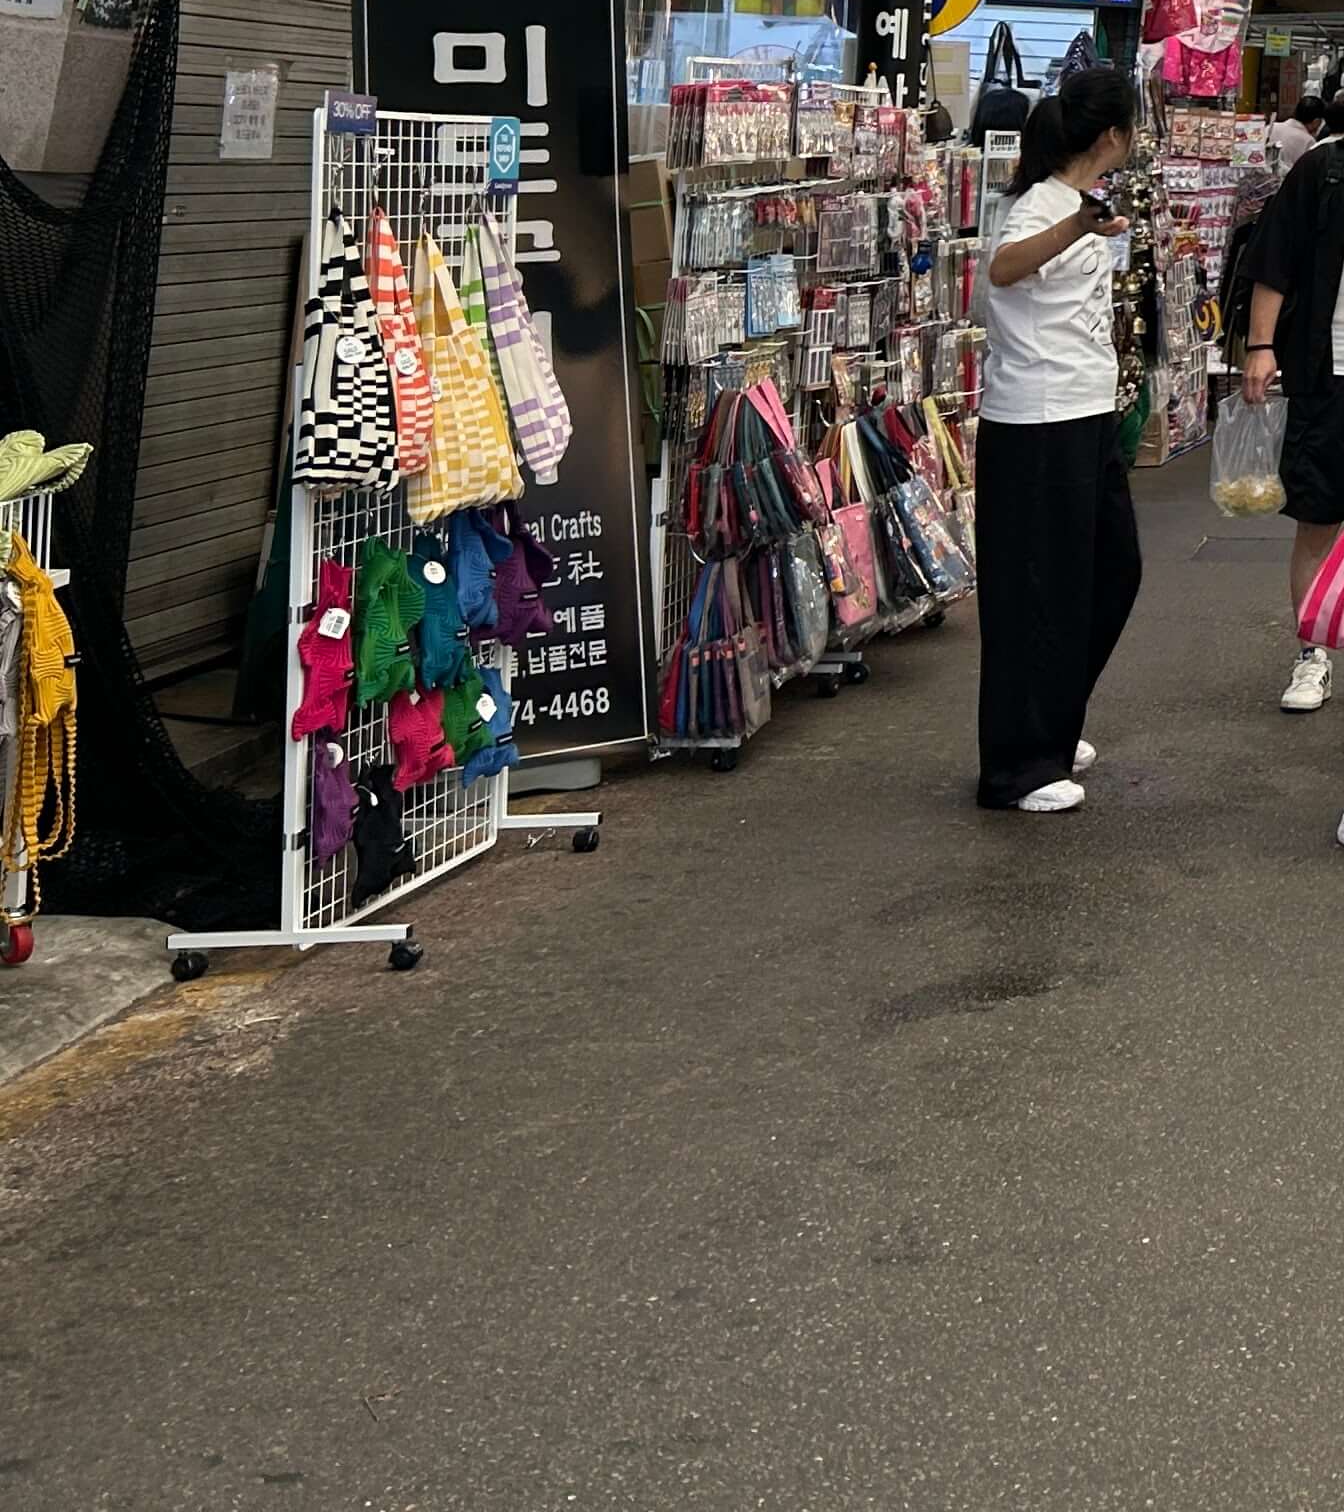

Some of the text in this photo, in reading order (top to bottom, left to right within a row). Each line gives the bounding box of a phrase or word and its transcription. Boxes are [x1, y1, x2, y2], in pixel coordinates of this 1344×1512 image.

[332, 100, 373, 121] 30% OFF
[551, 509, 602, 541] Crafts
